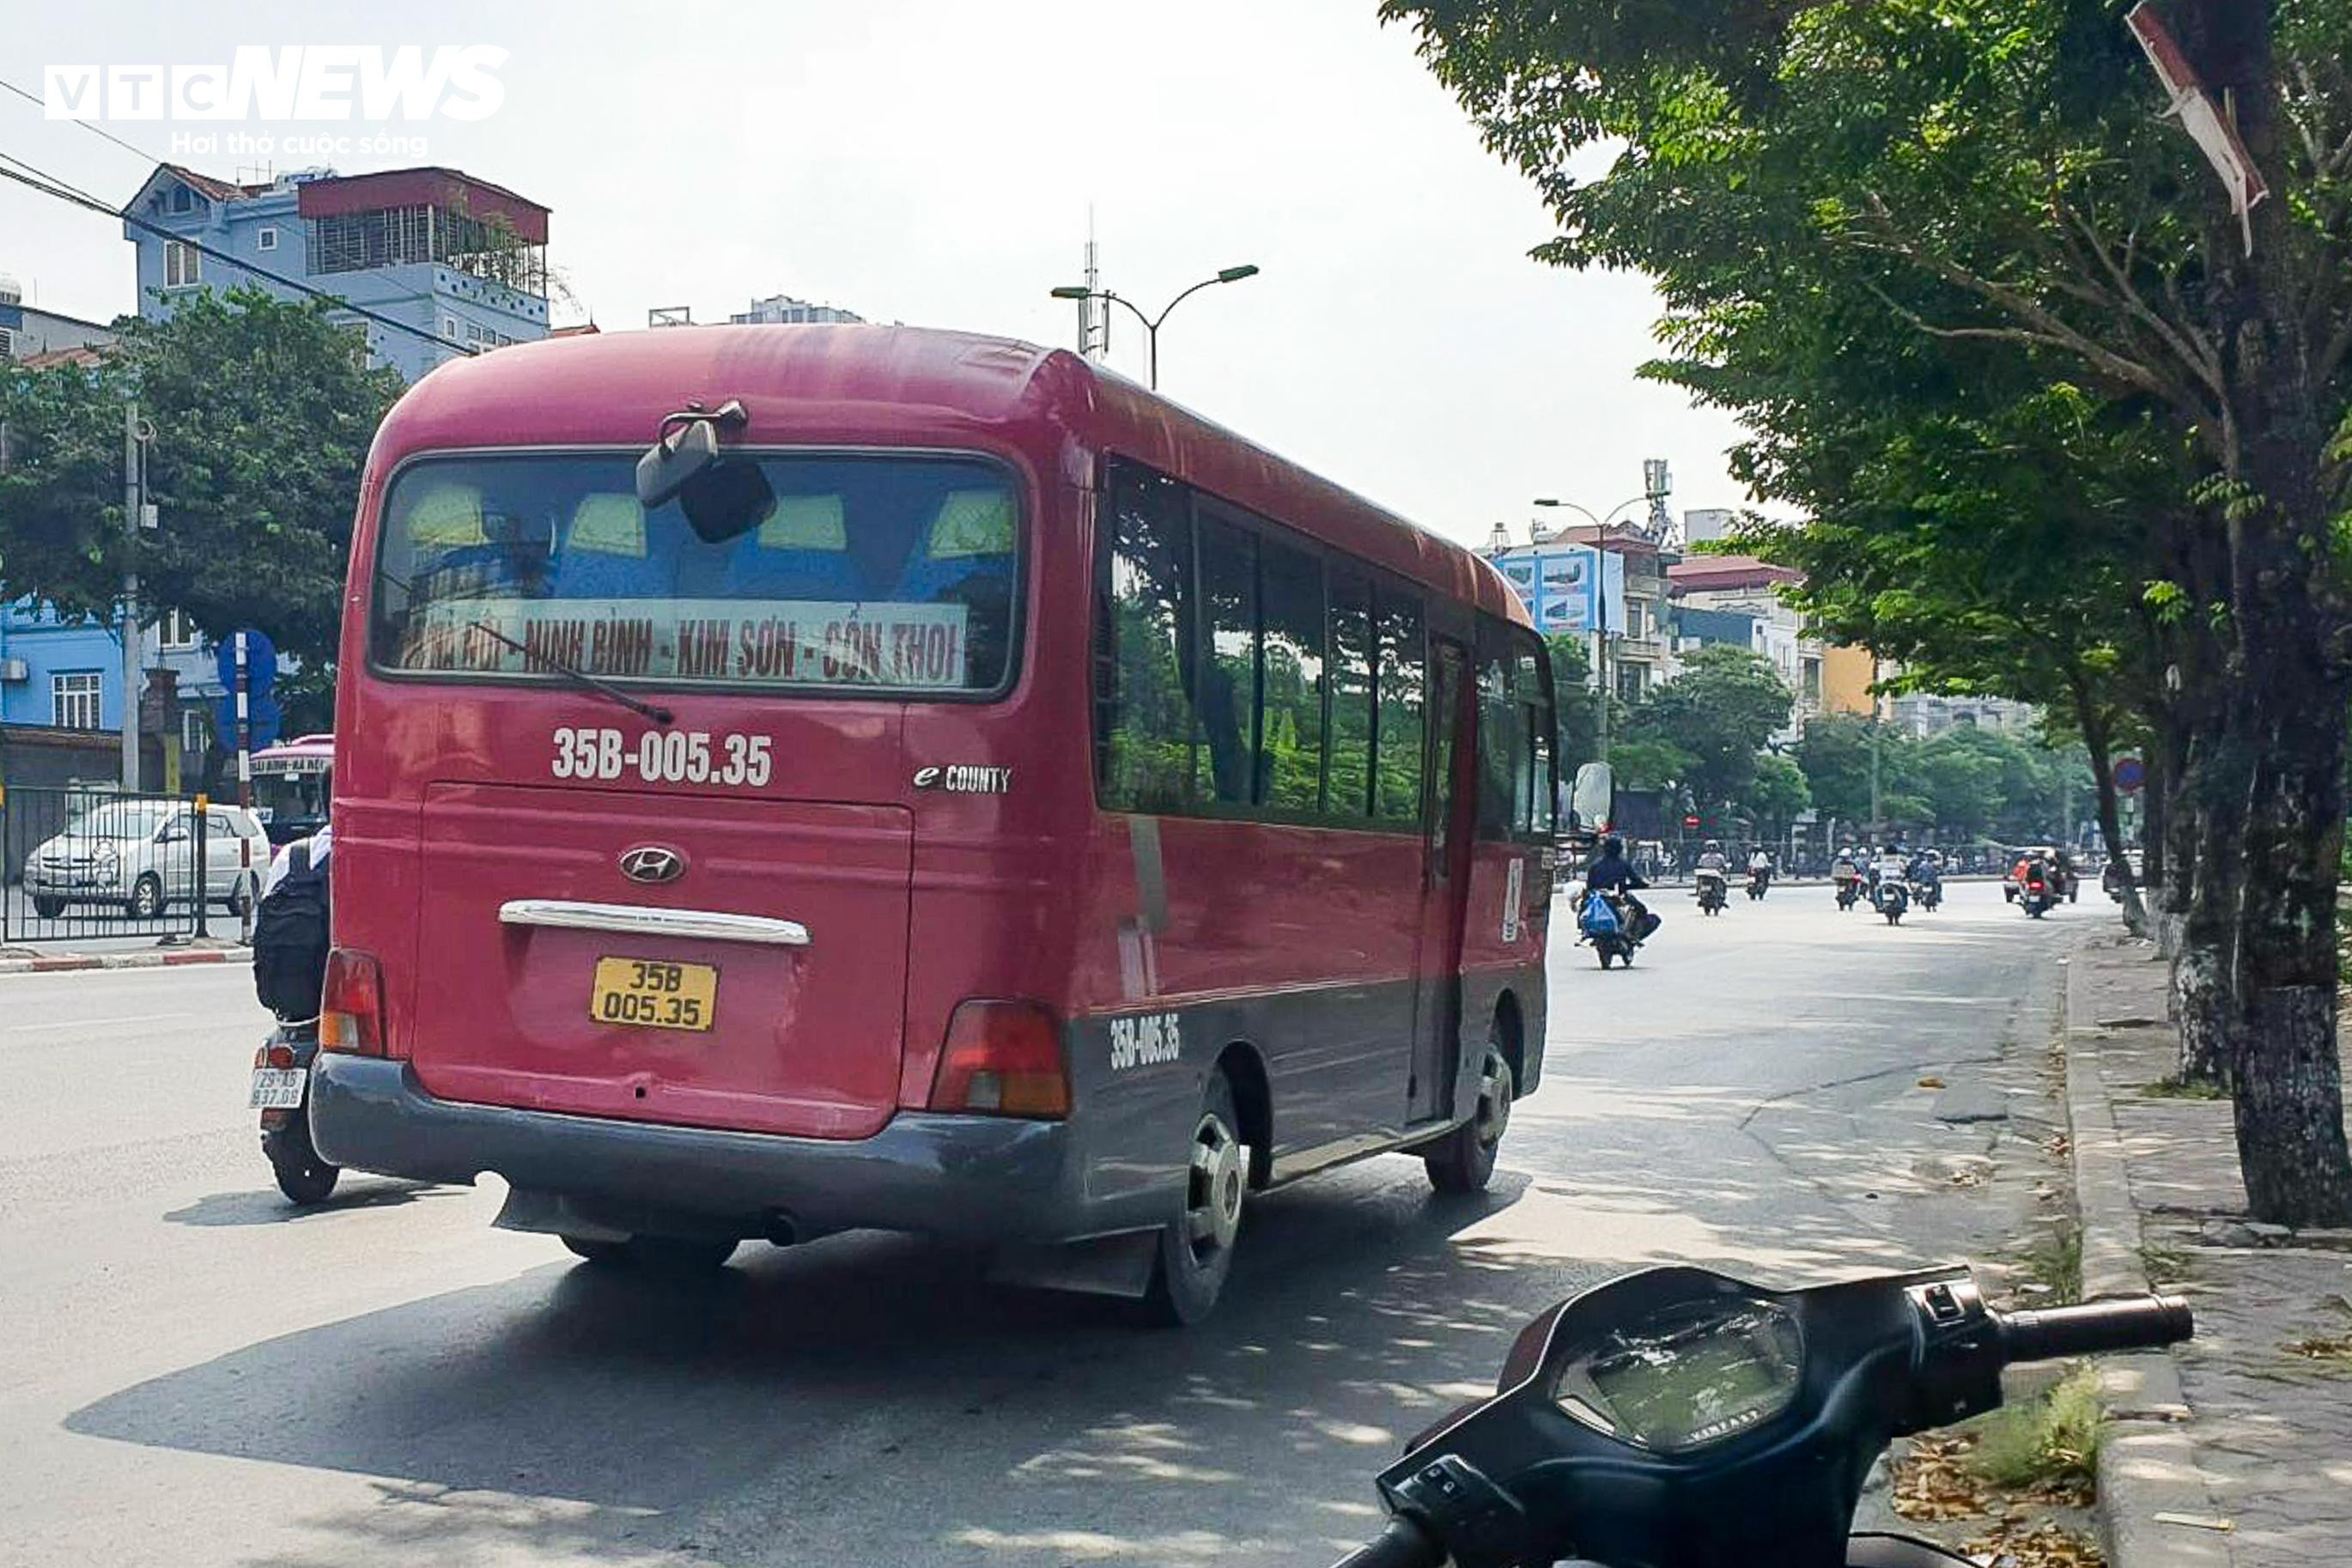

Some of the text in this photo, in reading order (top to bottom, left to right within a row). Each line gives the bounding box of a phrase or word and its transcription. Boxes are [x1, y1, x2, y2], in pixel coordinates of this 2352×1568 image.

[551, 726, 773, 787] 35B-005.35
[946, 764, 1012, 793] COUNTY
[629, 962, 683, 992] 35B
[604, 992, 702, 1026] 005.35
